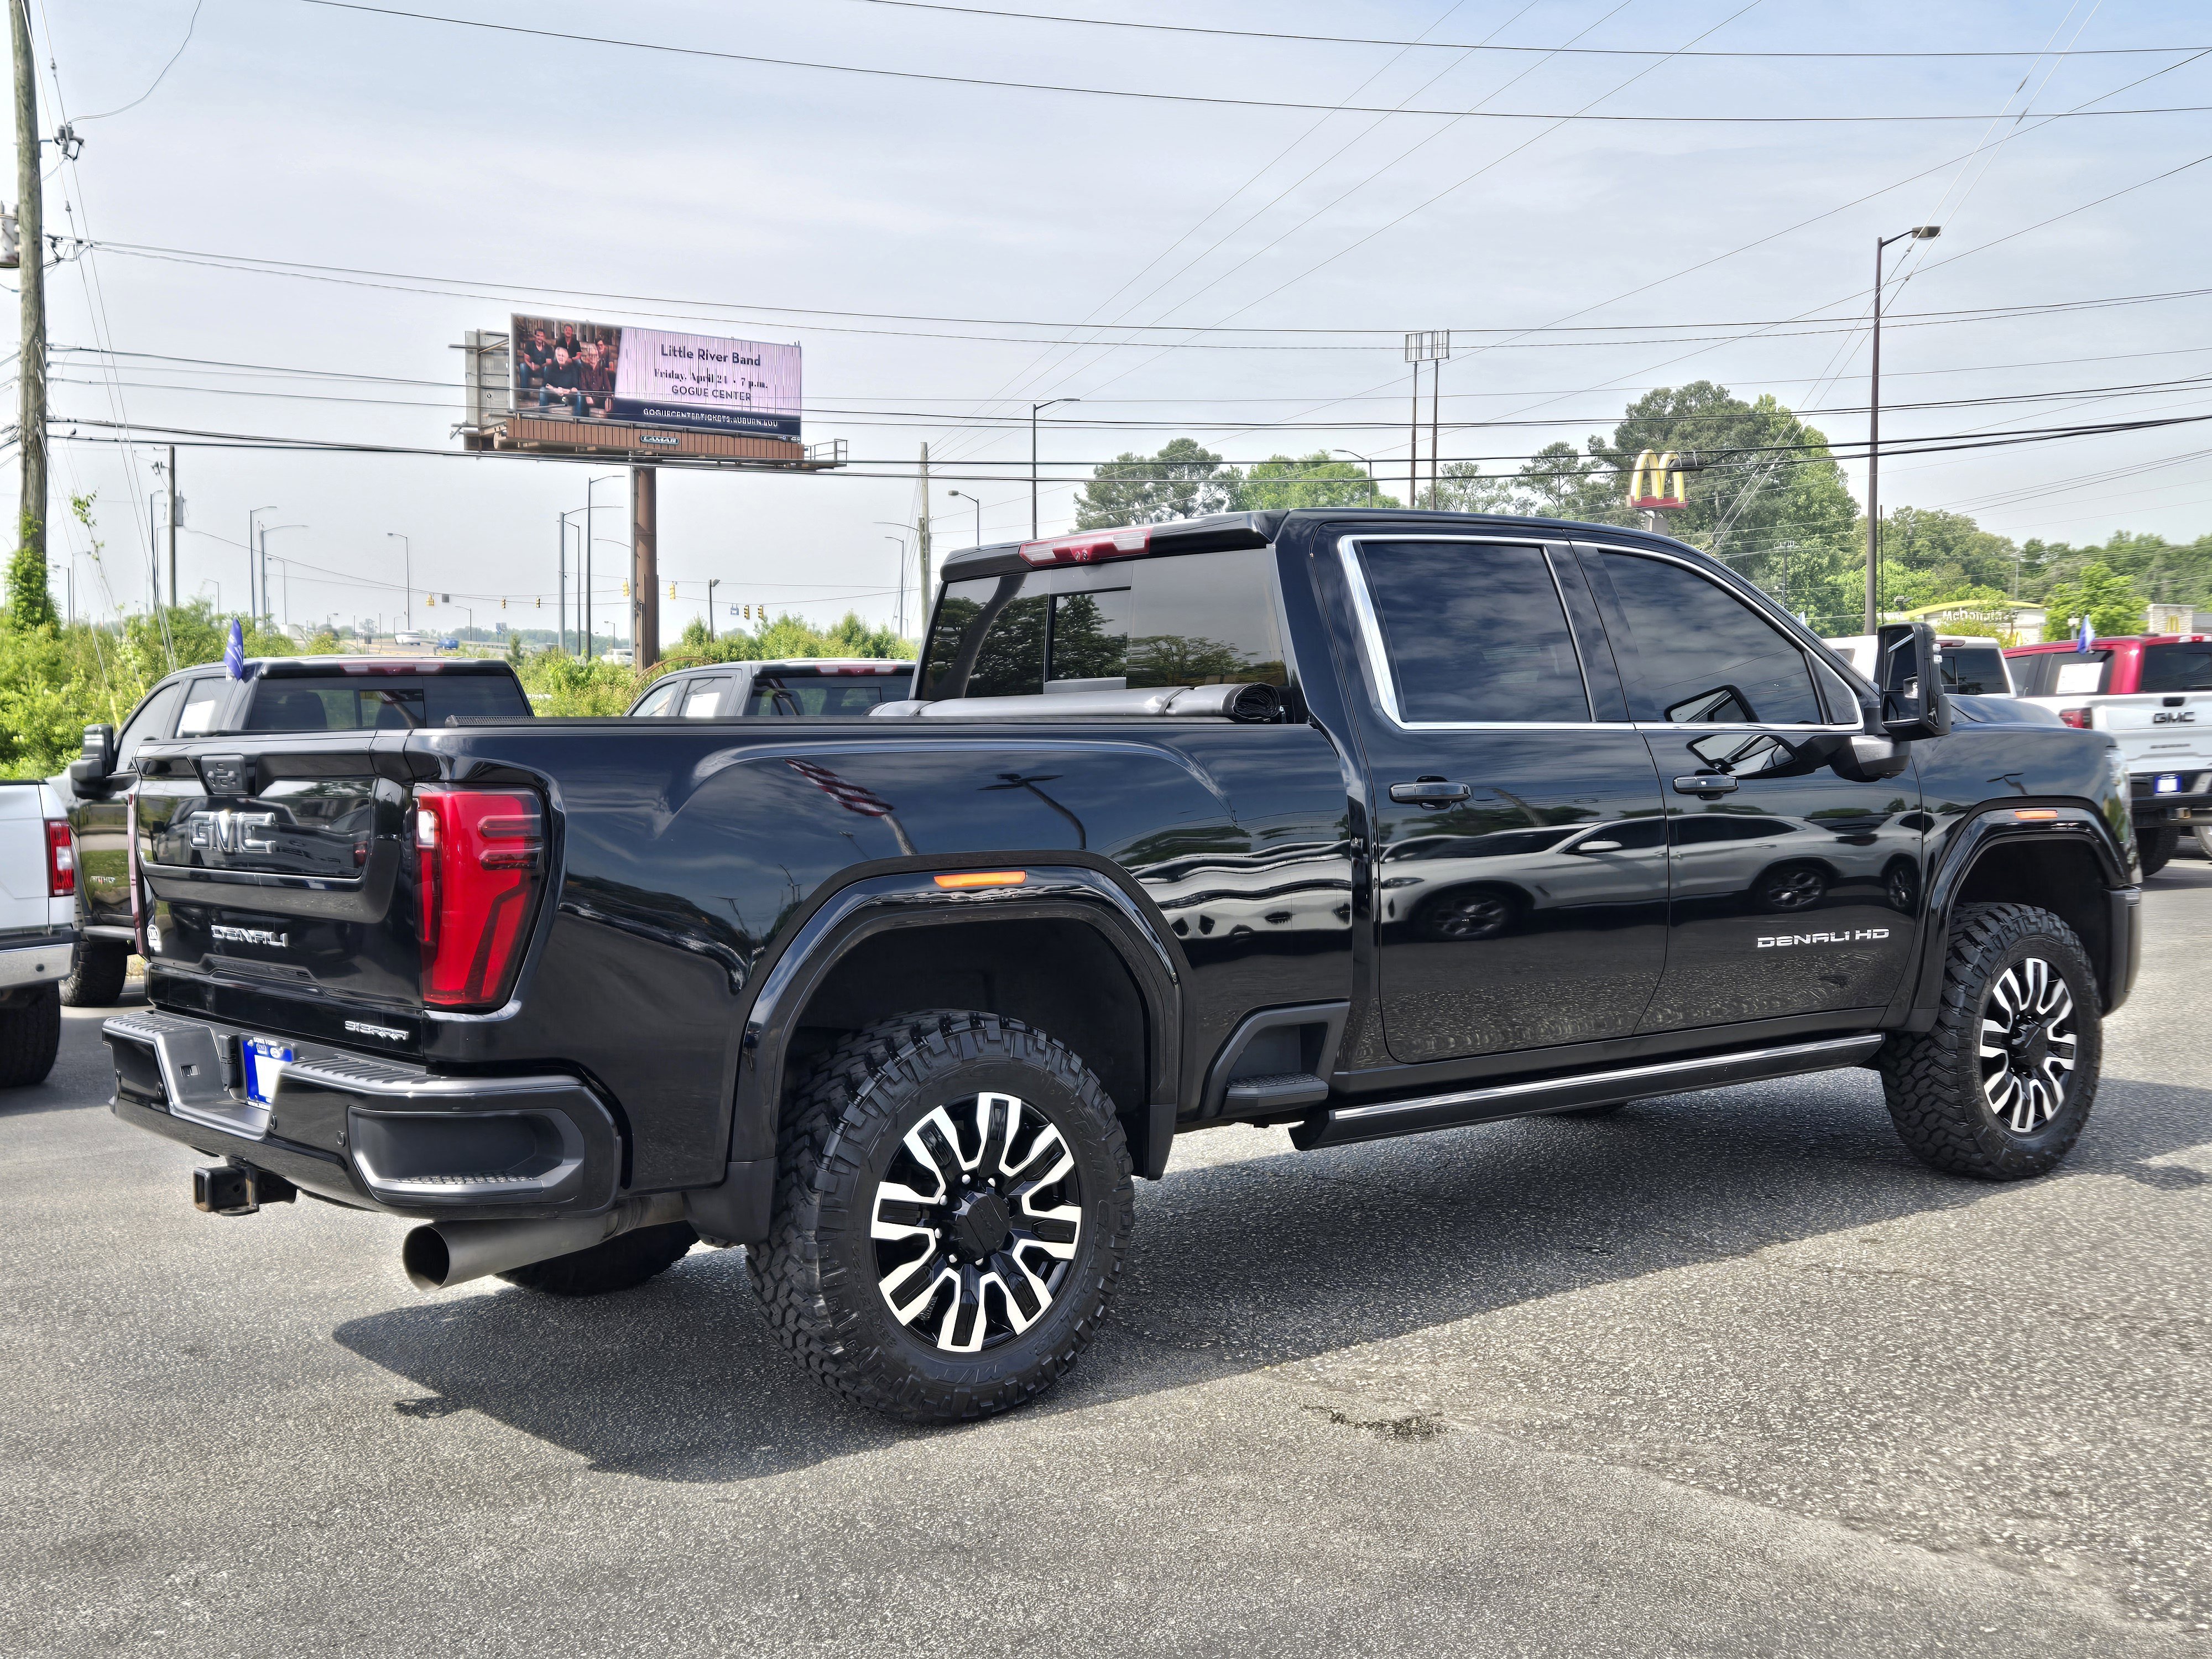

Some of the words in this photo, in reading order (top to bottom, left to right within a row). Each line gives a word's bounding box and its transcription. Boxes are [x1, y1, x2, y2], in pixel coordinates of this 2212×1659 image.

[661, 344, 693, 359] Little
[698, 348, 728, 362] River
[732, 352, 761, 366] Band
[654, 368, 686, 382] Friday,
[691, 372, 713, 384] April
[741, 377, 745, 387] 7
[671, 385, 708, 397] GOGUE
[712, 389, 751, 401] CENTER
[1943, 607, 2010, 622] McDonal
[2153, 712, 2195, 724] GMC
[189, 810, 276, 854] GMC
[211, 925, 289, 947] DENALI
[1757, 931, 1850, 948] DENALI
[1855, 928, 1890, 940] HD
[345, 1020, 409, 1041] SIERRA
